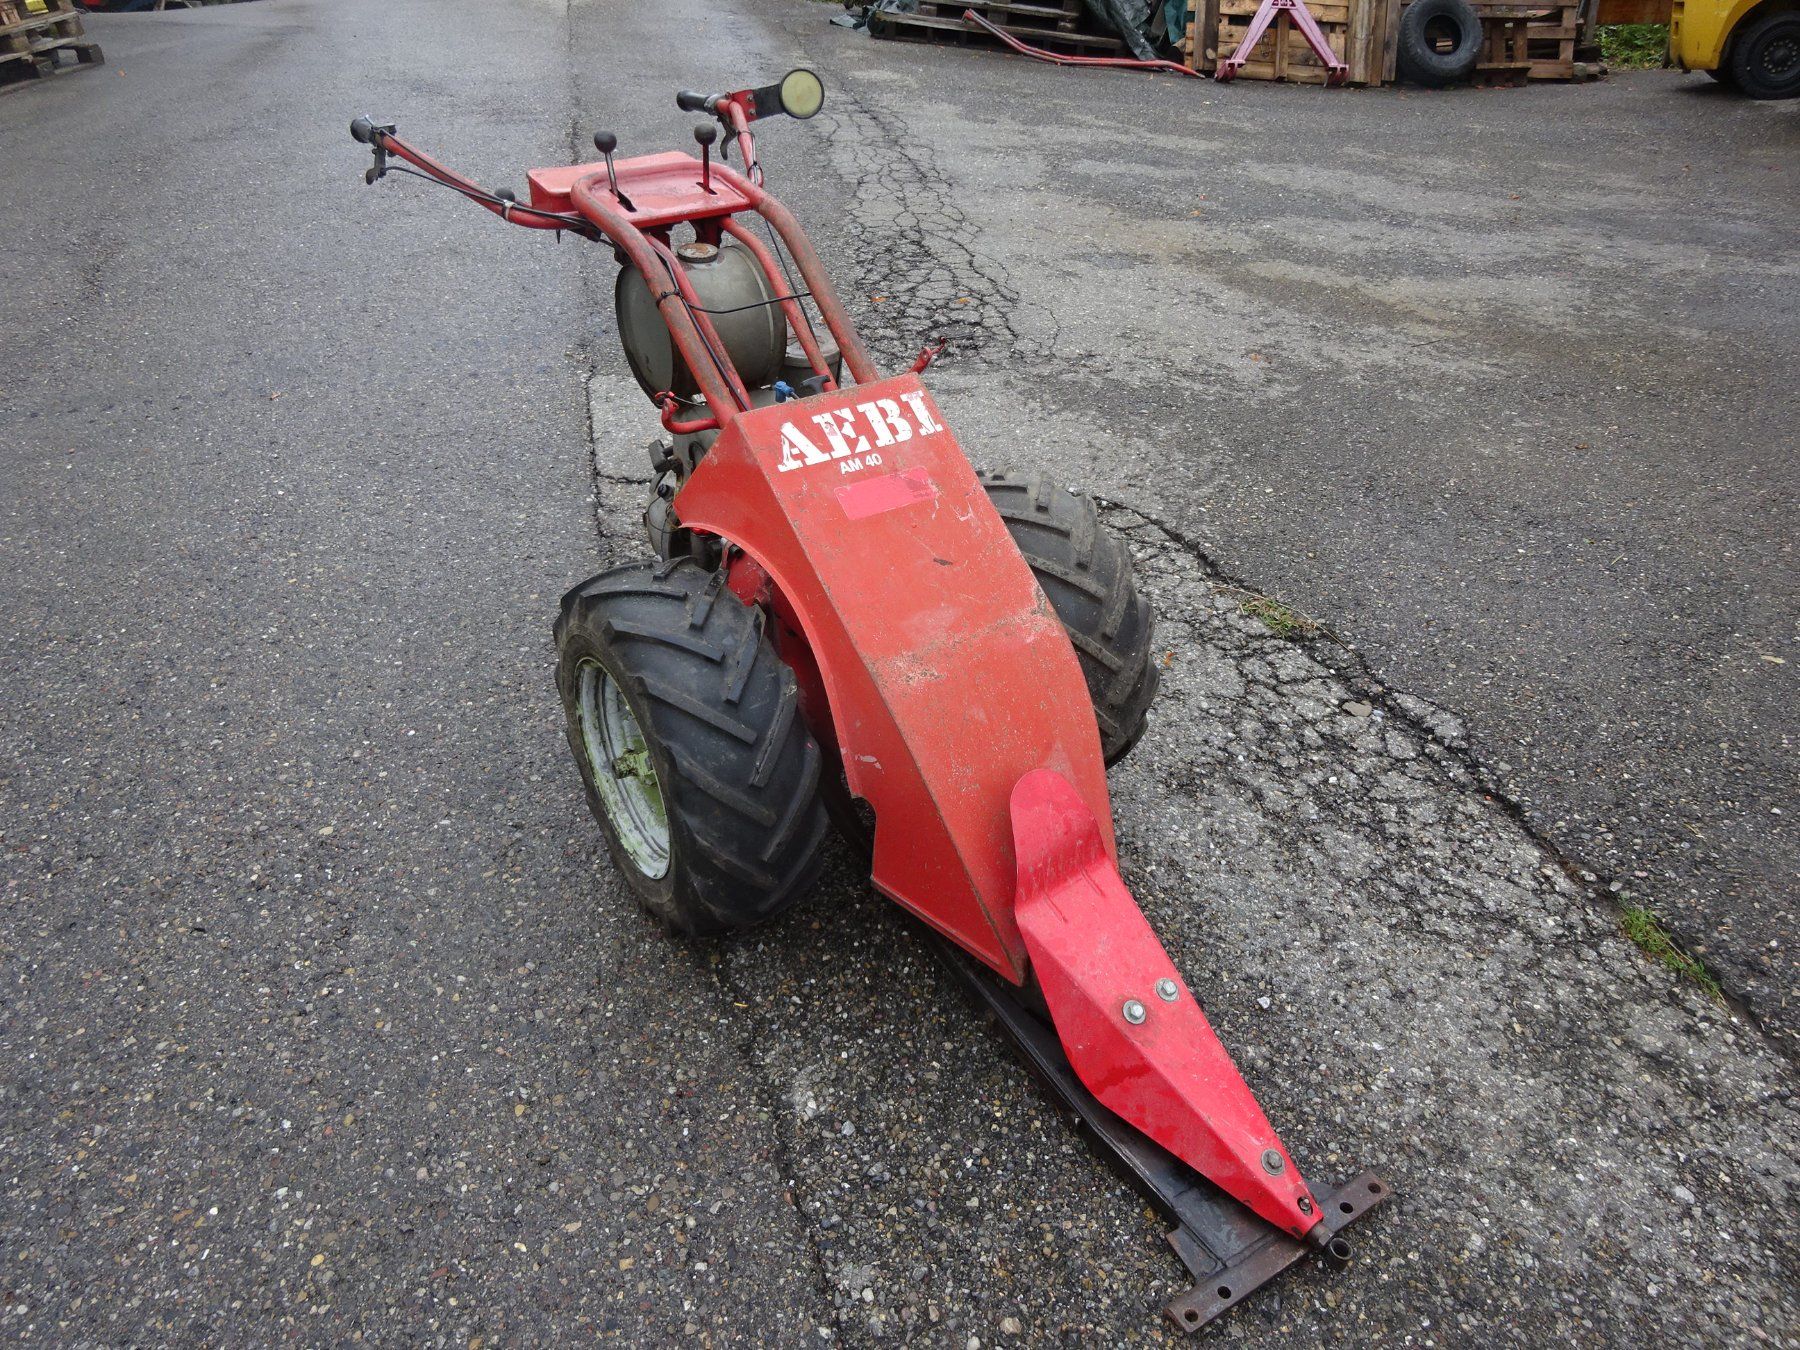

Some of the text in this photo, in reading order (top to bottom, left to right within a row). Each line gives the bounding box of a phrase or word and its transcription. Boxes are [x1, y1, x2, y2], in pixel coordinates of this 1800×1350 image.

[777, 390, 943, 472] AEBI
[839, 453, 883, 474] AM 40
